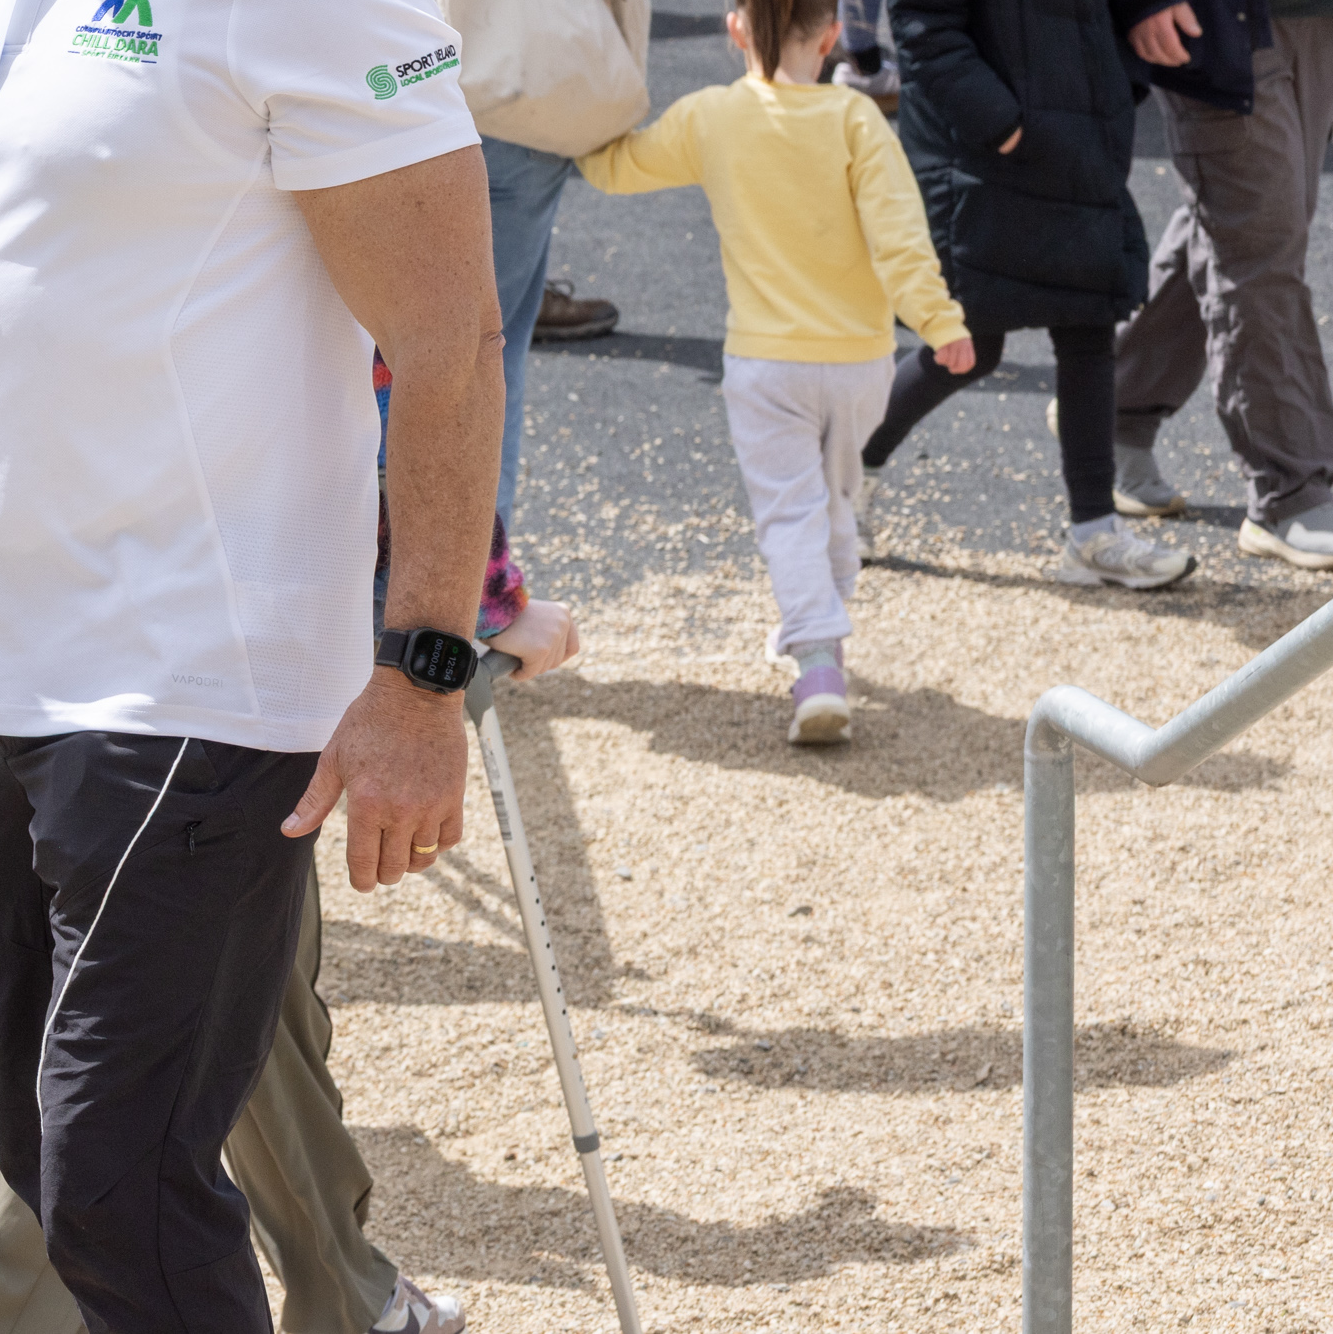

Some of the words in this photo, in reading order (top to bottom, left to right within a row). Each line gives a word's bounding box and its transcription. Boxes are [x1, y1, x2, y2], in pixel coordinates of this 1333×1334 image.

[72, 33, 111, 50] CHILL
[114, 37, 159, 57] DARA
[396, 53, 434, 78] SPORT
[400, 74, 425, 87] LOCAL
[427, 638, 444, 677] 00:00.00
[444, 656, 457, 681] 12:54
[171, 673, 224, 688] VAPODRI
